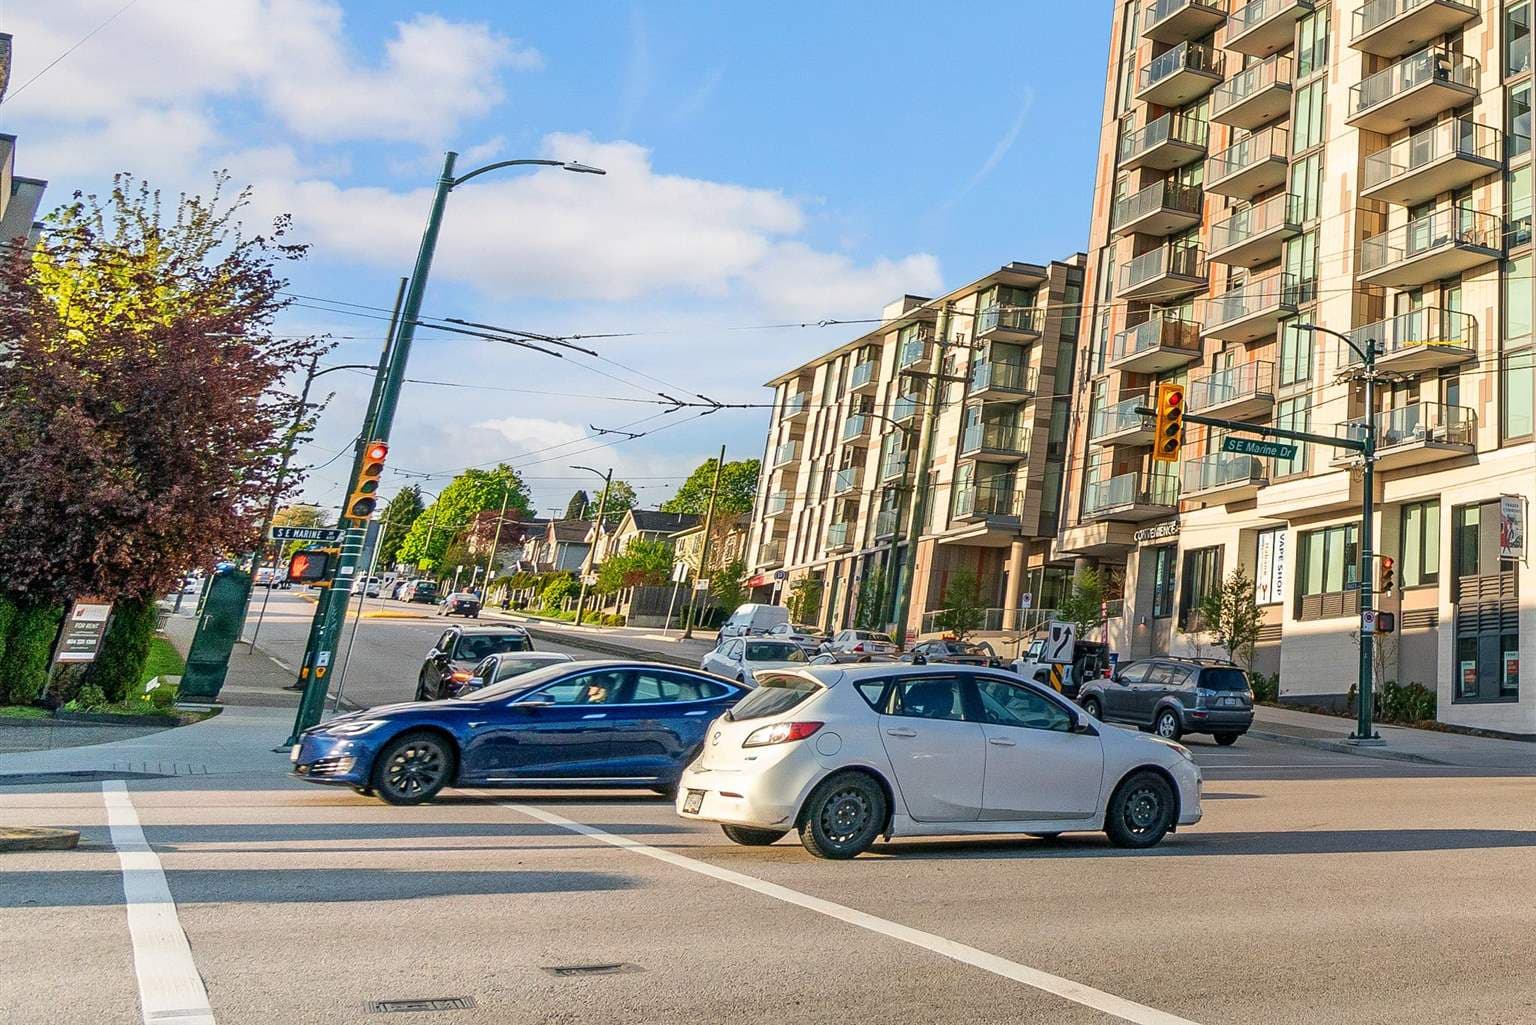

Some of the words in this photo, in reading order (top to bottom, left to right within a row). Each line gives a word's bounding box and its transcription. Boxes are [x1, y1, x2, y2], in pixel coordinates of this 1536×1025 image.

[1228, 439, 1244, 451] SE
[1245, 442, 1277, 455] Marine
[1280, 446, 1292, 457] Dr
[292, 529, 322, 539] MARINE
